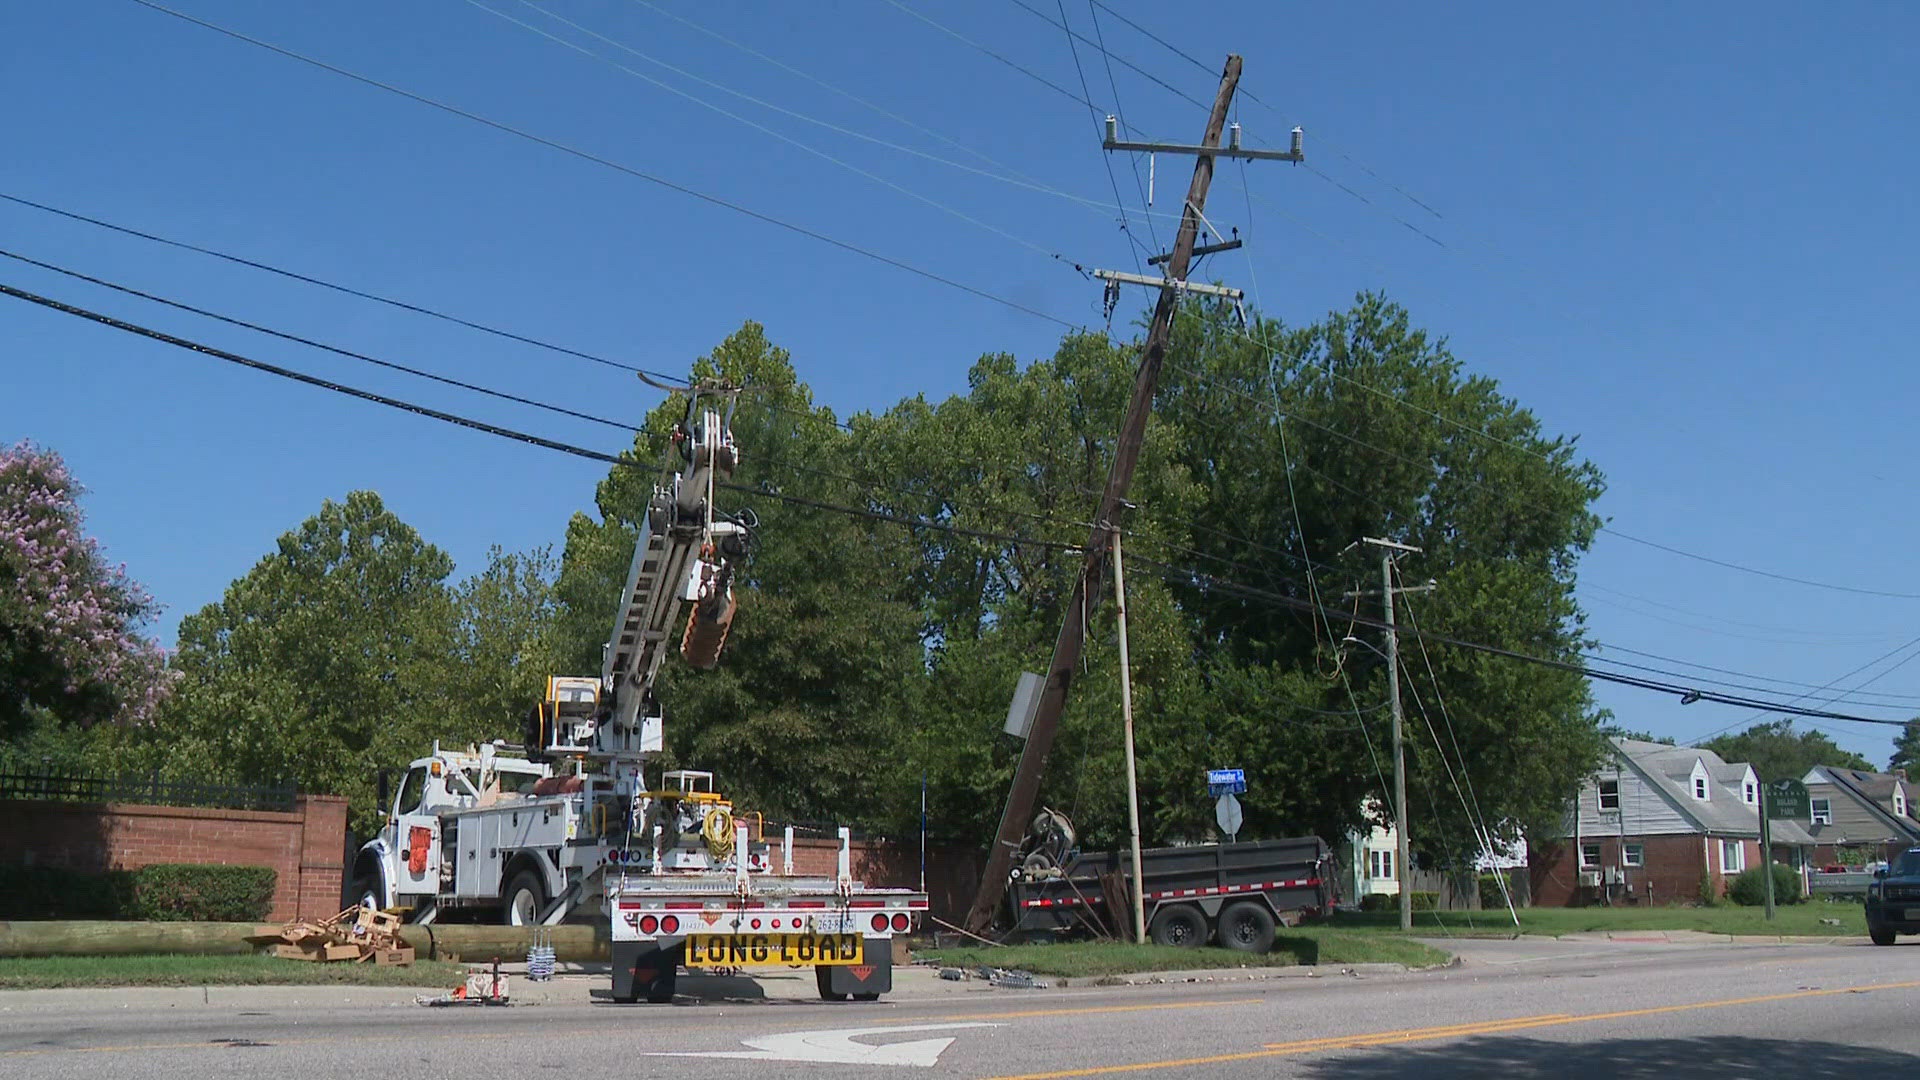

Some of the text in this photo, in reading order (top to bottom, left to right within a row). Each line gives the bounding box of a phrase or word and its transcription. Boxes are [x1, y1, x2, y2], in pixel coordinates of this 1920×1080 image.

[1209, 771, 1236, 782] Tidewater
[690, 934, 858, 963] LONG LOAD
